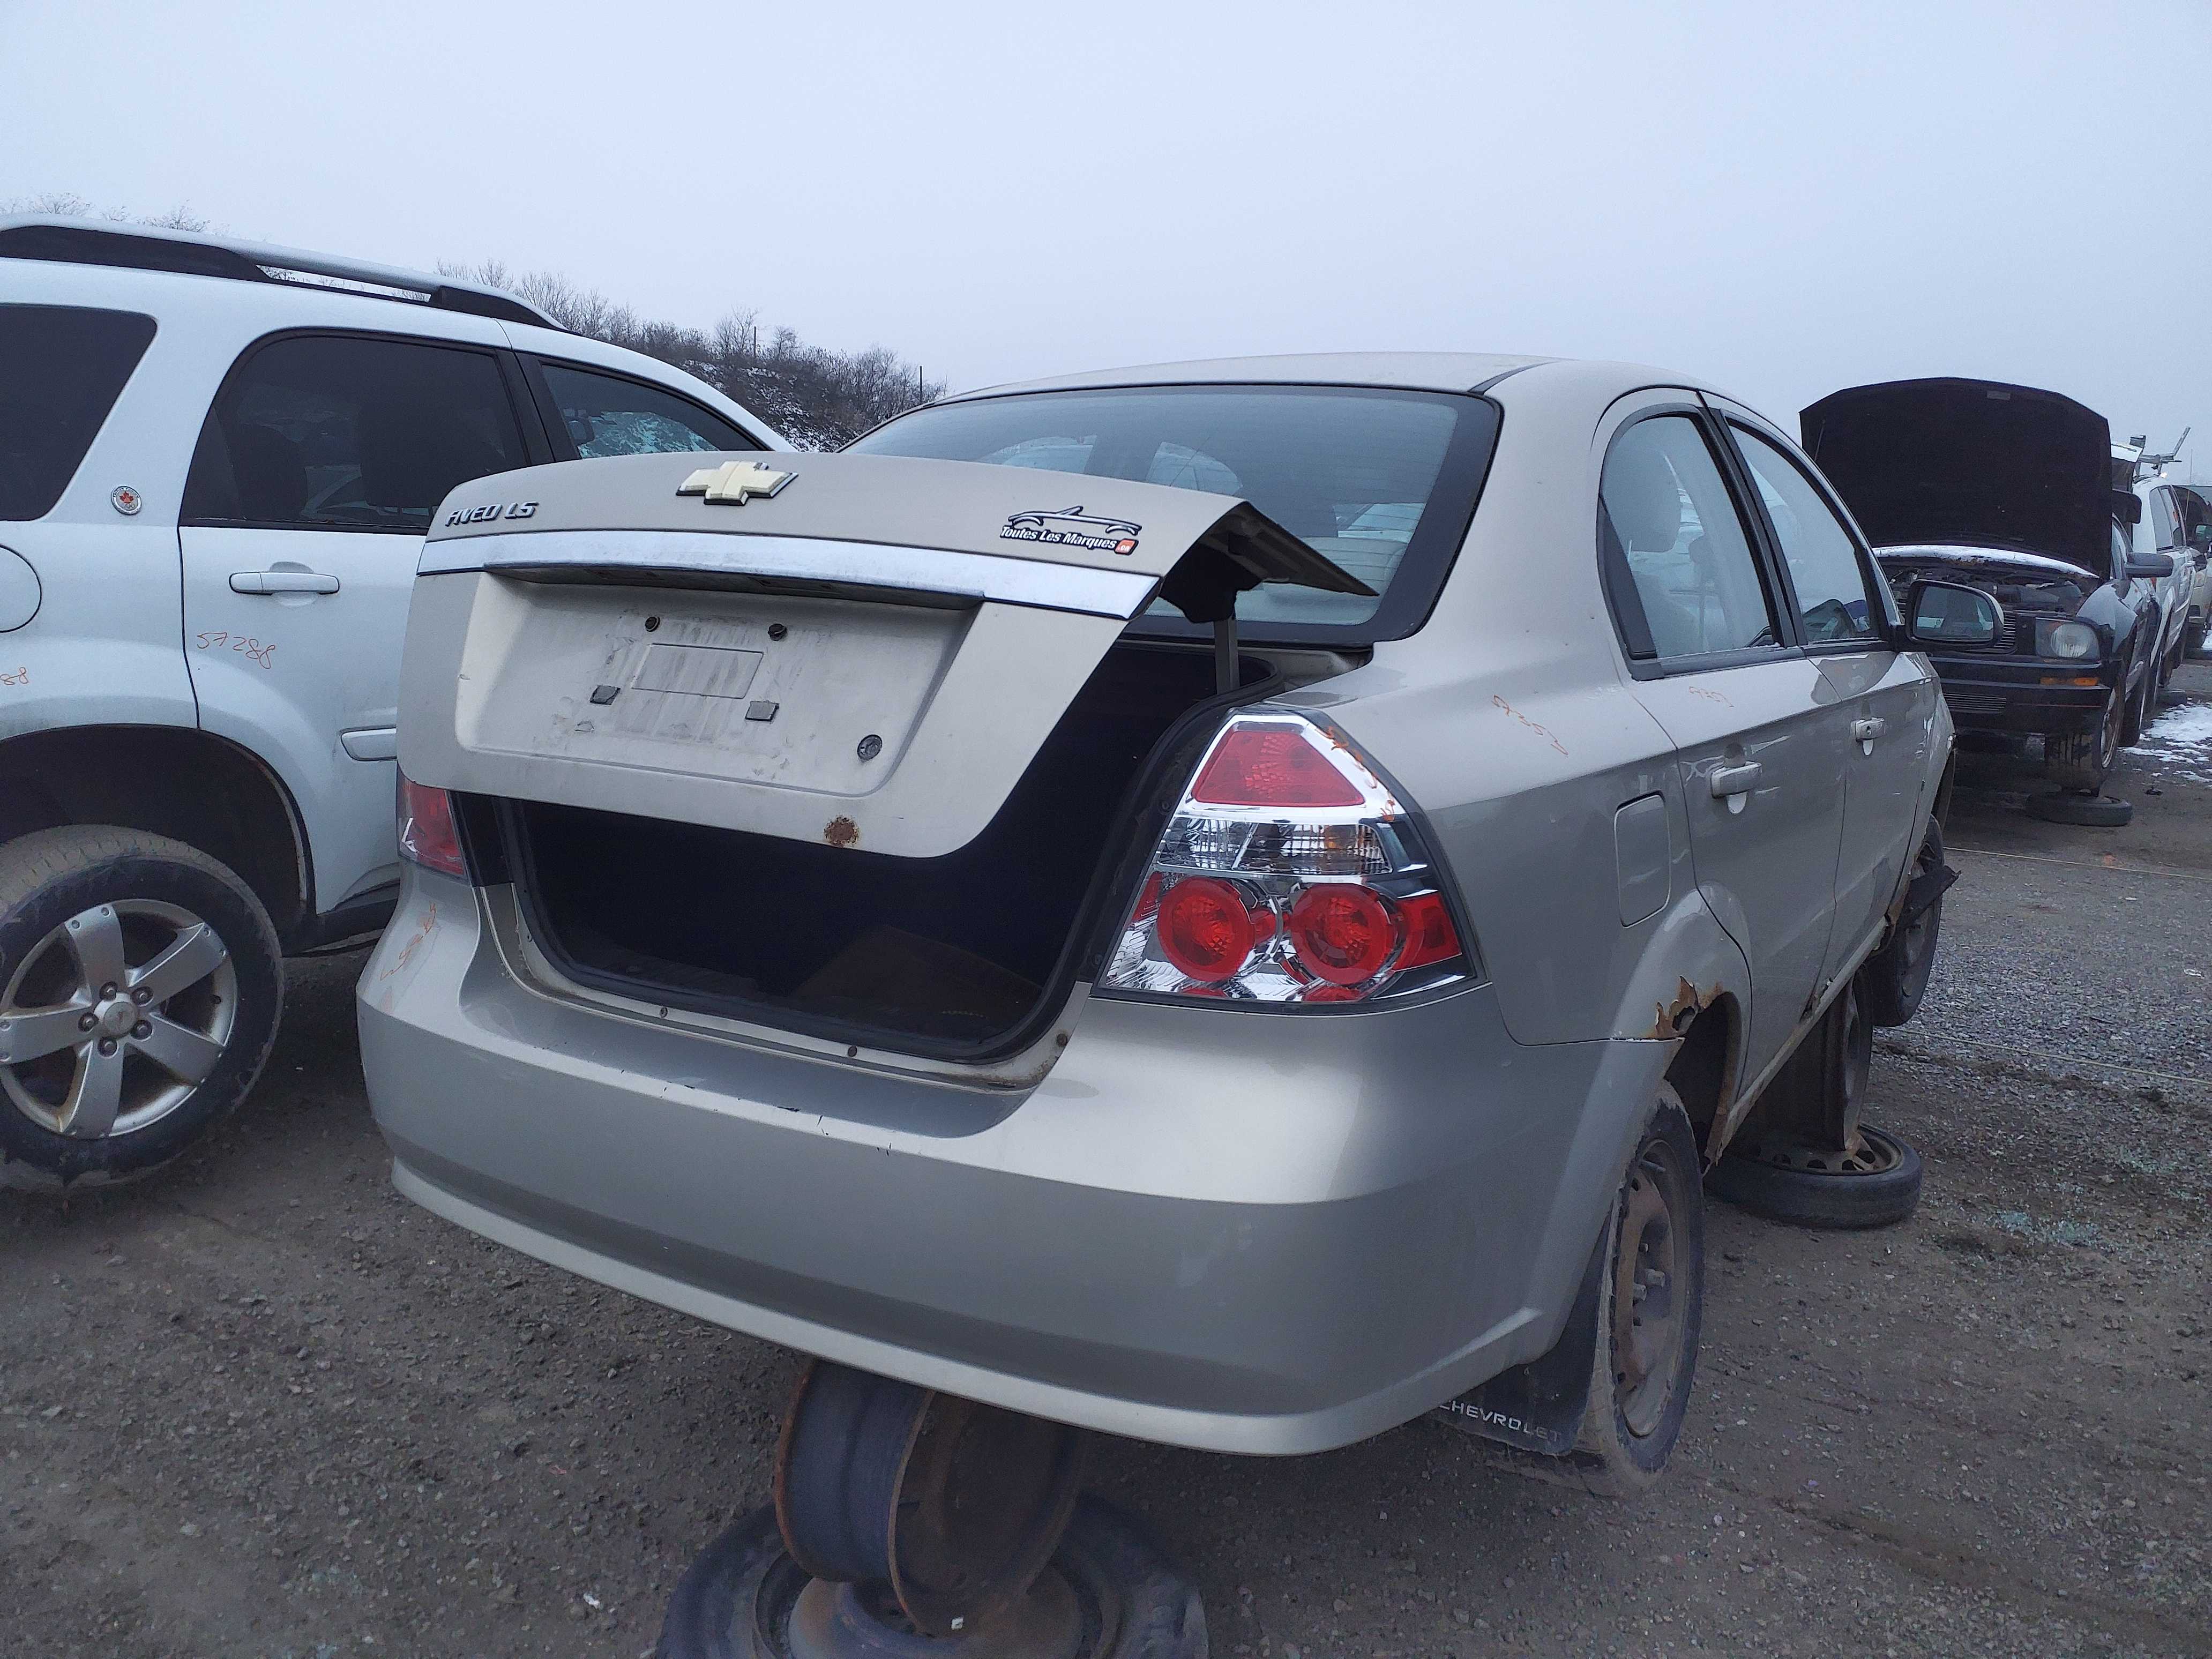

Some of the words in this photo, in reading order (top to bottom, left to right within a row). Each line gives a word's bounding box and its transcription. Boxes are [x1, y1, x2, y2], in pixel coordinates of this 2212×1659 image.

[445, 504, 503, 527] AVEO
[504, 501, 539, 519] LS
[1000, 526, 1038, 540] Toutes
[1039, 530, 1062, 542] Les
[1062, 533, 1118, 549] Marques
